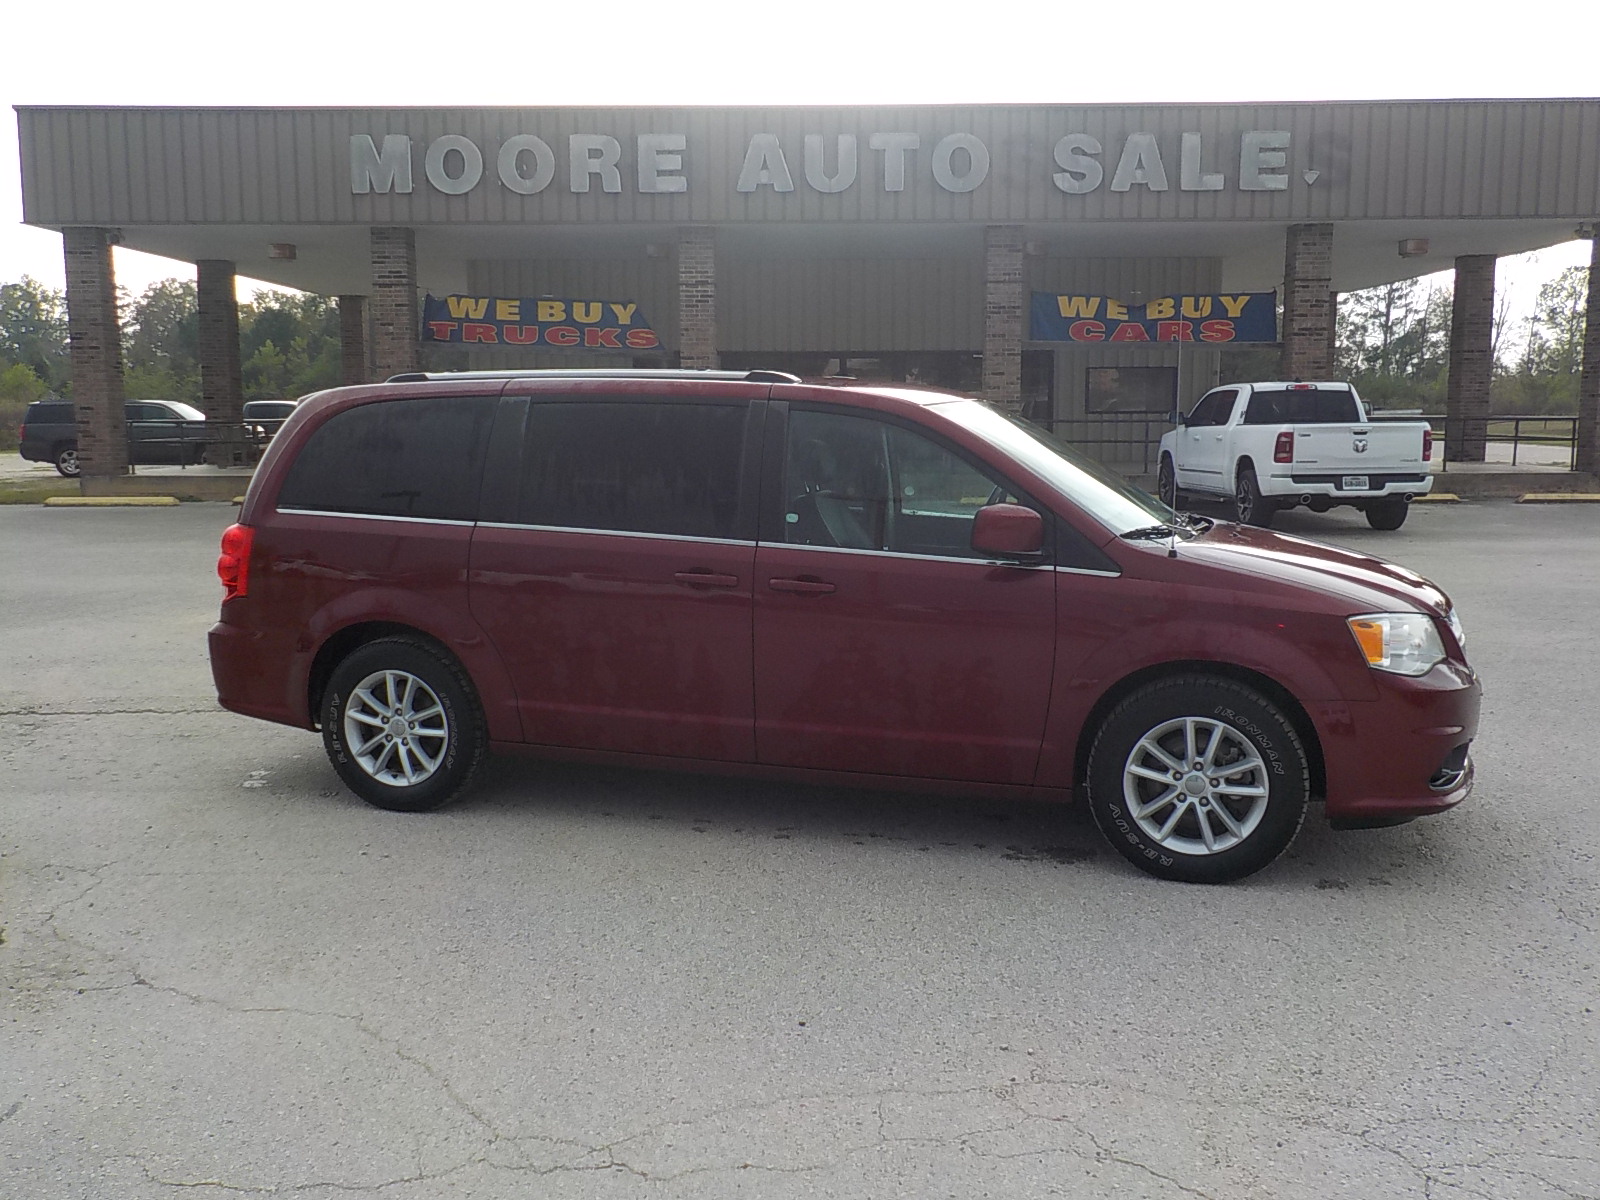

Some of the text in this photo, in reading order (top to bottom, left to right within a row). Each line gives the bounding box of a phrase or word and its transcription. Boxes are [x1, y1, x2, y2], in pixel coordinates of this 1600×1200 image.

[350, 133, 687, 195] MOORE
[736, 132, 991, 193] AUTO
[446, 296, 637, 325] WE BUY
[1056, 295, 1251, 320] WE BUY
[428, 321, 660, 349] TRUCKS
[1069, 320, 1236, 342] CARS
[1213, 705, 1285, 776] IRONMAN
